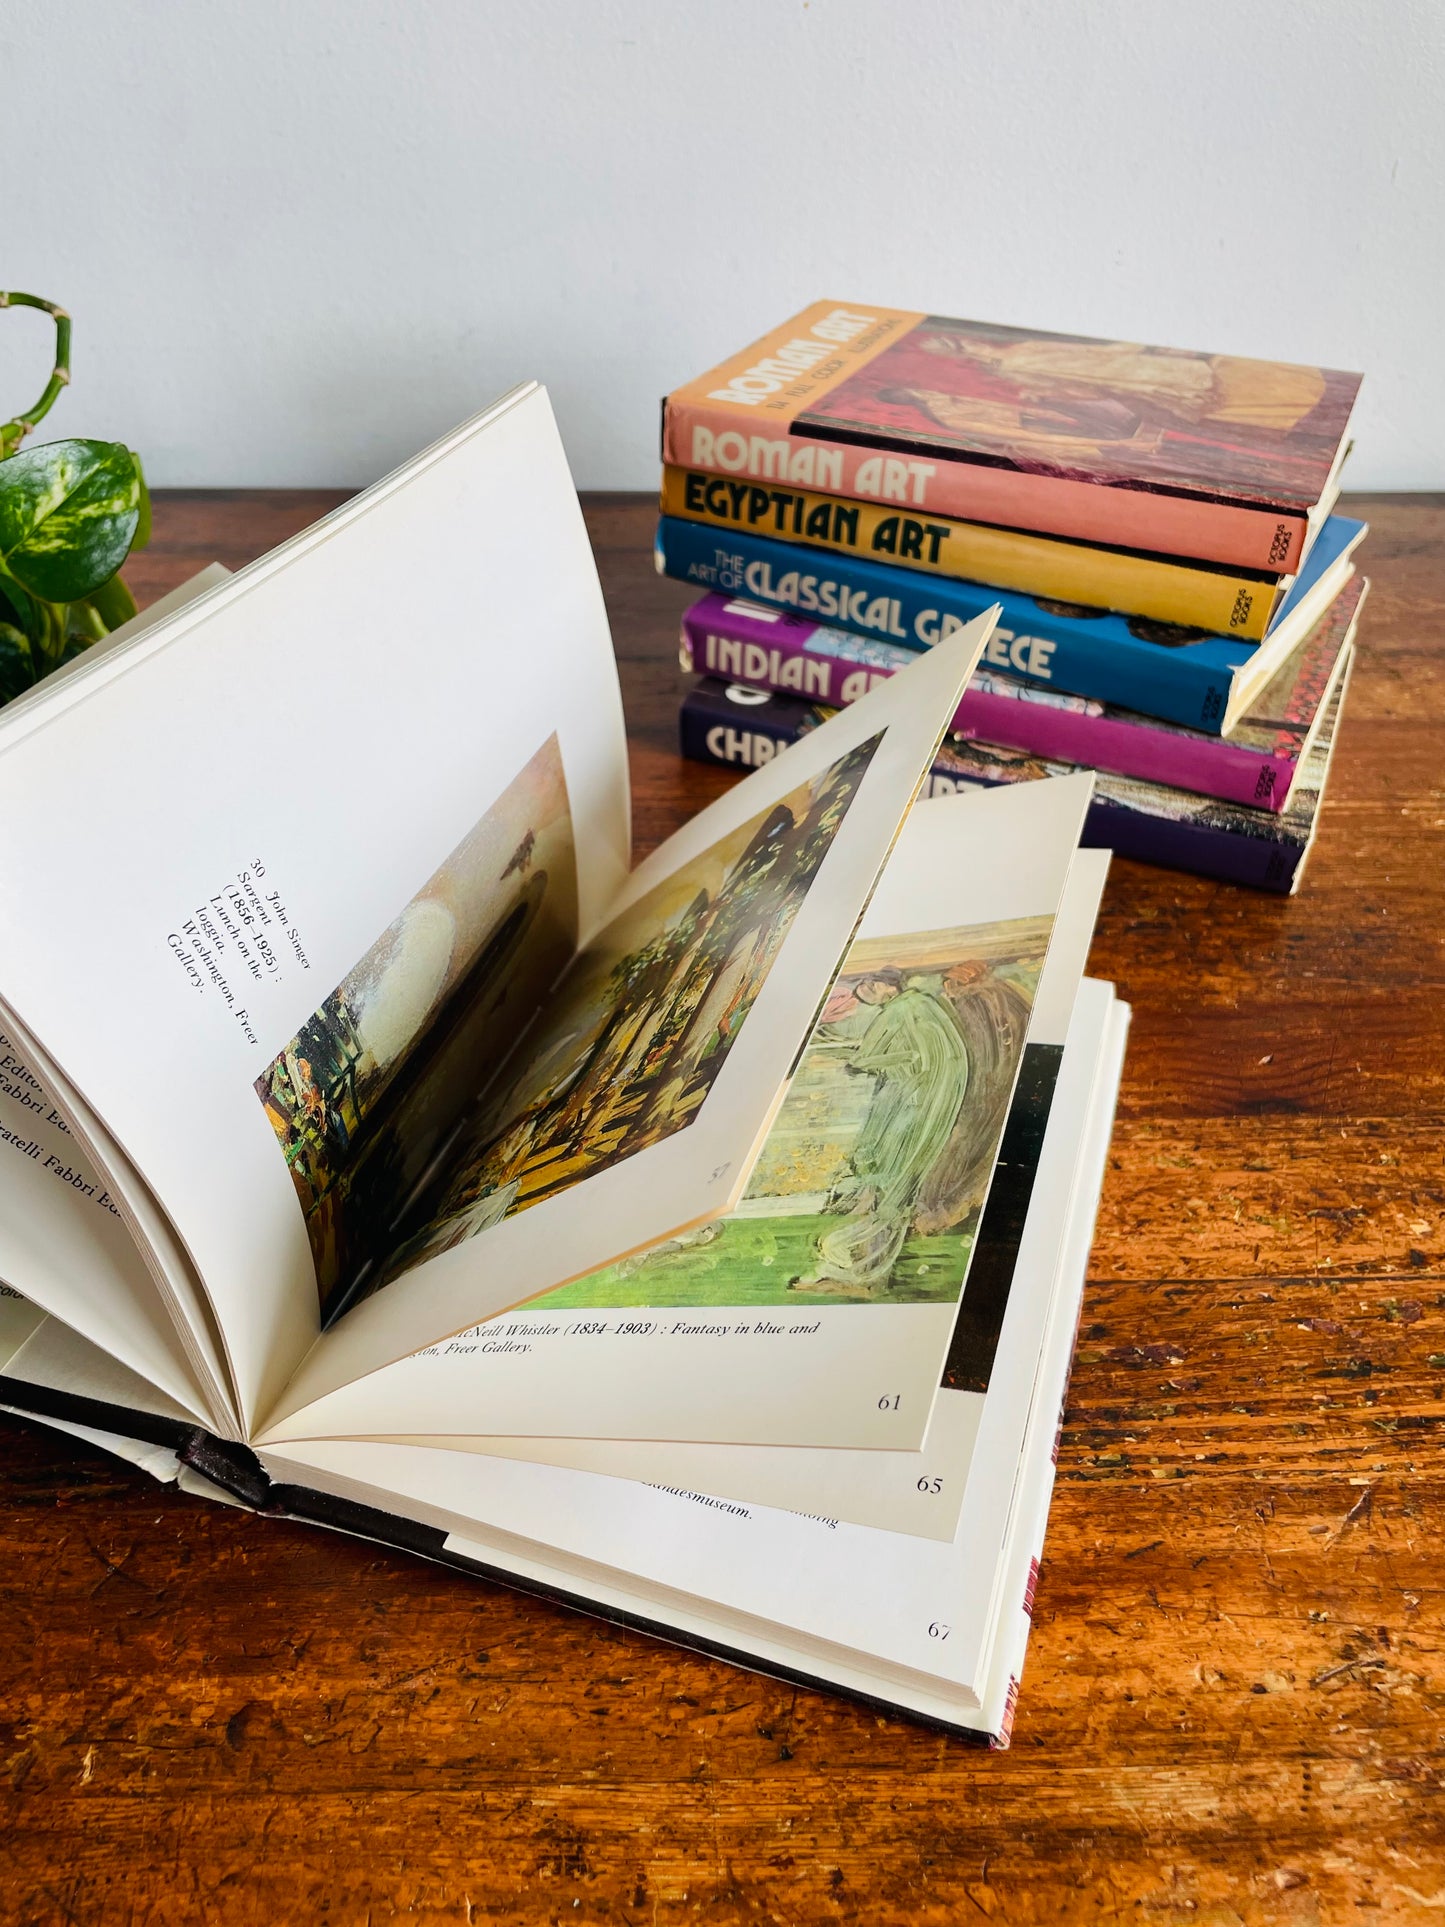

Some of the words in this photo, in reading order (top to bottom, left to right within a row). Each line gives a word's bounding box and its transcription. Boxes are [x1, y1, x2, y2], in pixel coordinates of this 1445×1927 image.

[706, 338, 839, 405] ROMAN
[810, 308, 877, 342] ART
[692, 425, 844, 490] ROMAN
[855, 457, 936, 504] ART
[685, 473, 859, 545] EGYPTIAN
[872, 516, 951, 565] ART
[714, 549, 745, 573] THE
[1268, 524, 1285, 565] OCTOPUS
[1278, 531, 1293, 561] BOOKS
[687, 562, 717, 583] ART
[719, 571, 744, 589] OF
[744, 560, 907, 639] CLASSICAL
[914, 608, 1057, 679] GRECE
[1229, 588, 1247, 628] OCTOPUS
[1239, 595, 1253, 624] BOOKS
[706, 634, 831, 697] INDIAN
[237, 871, 272, 926] Sargent
[250, 858, 266, 878] 30
[265, 891, 289, 926] John
[287, 928, 311, 970] Singer
[195, 906, 226, 955] loggia.
[209, 894, 241, 940] Lunch
[237, 941, 251, 959] on
[247, 958, 263, 982] the
[167, 933, 205, 994] Gallery.
[181, 918, 236, 1009] Washington,
[235, 1009, 258, 1046] Freer
[0, 1120, 44, 1160] ratelli
[43, 1154, 99, 1197] Fabbri
[444, 1342, 479, 1355] Freer
[481, 1340, 533, 1354] Gallery.
[506, 1323, 560, 1336] Whistler
[671, 1322, 731, 1337] Fantasy
[734, 1322, 751, 1334] in
[753, 1322, 785, 1334] blue
[788, 1322, 821, 1334] and
[877, 1394, 902, 1411] 61
[917, 1475, 944, 1495] 65
[927, 1621, 953, 1641] 67
